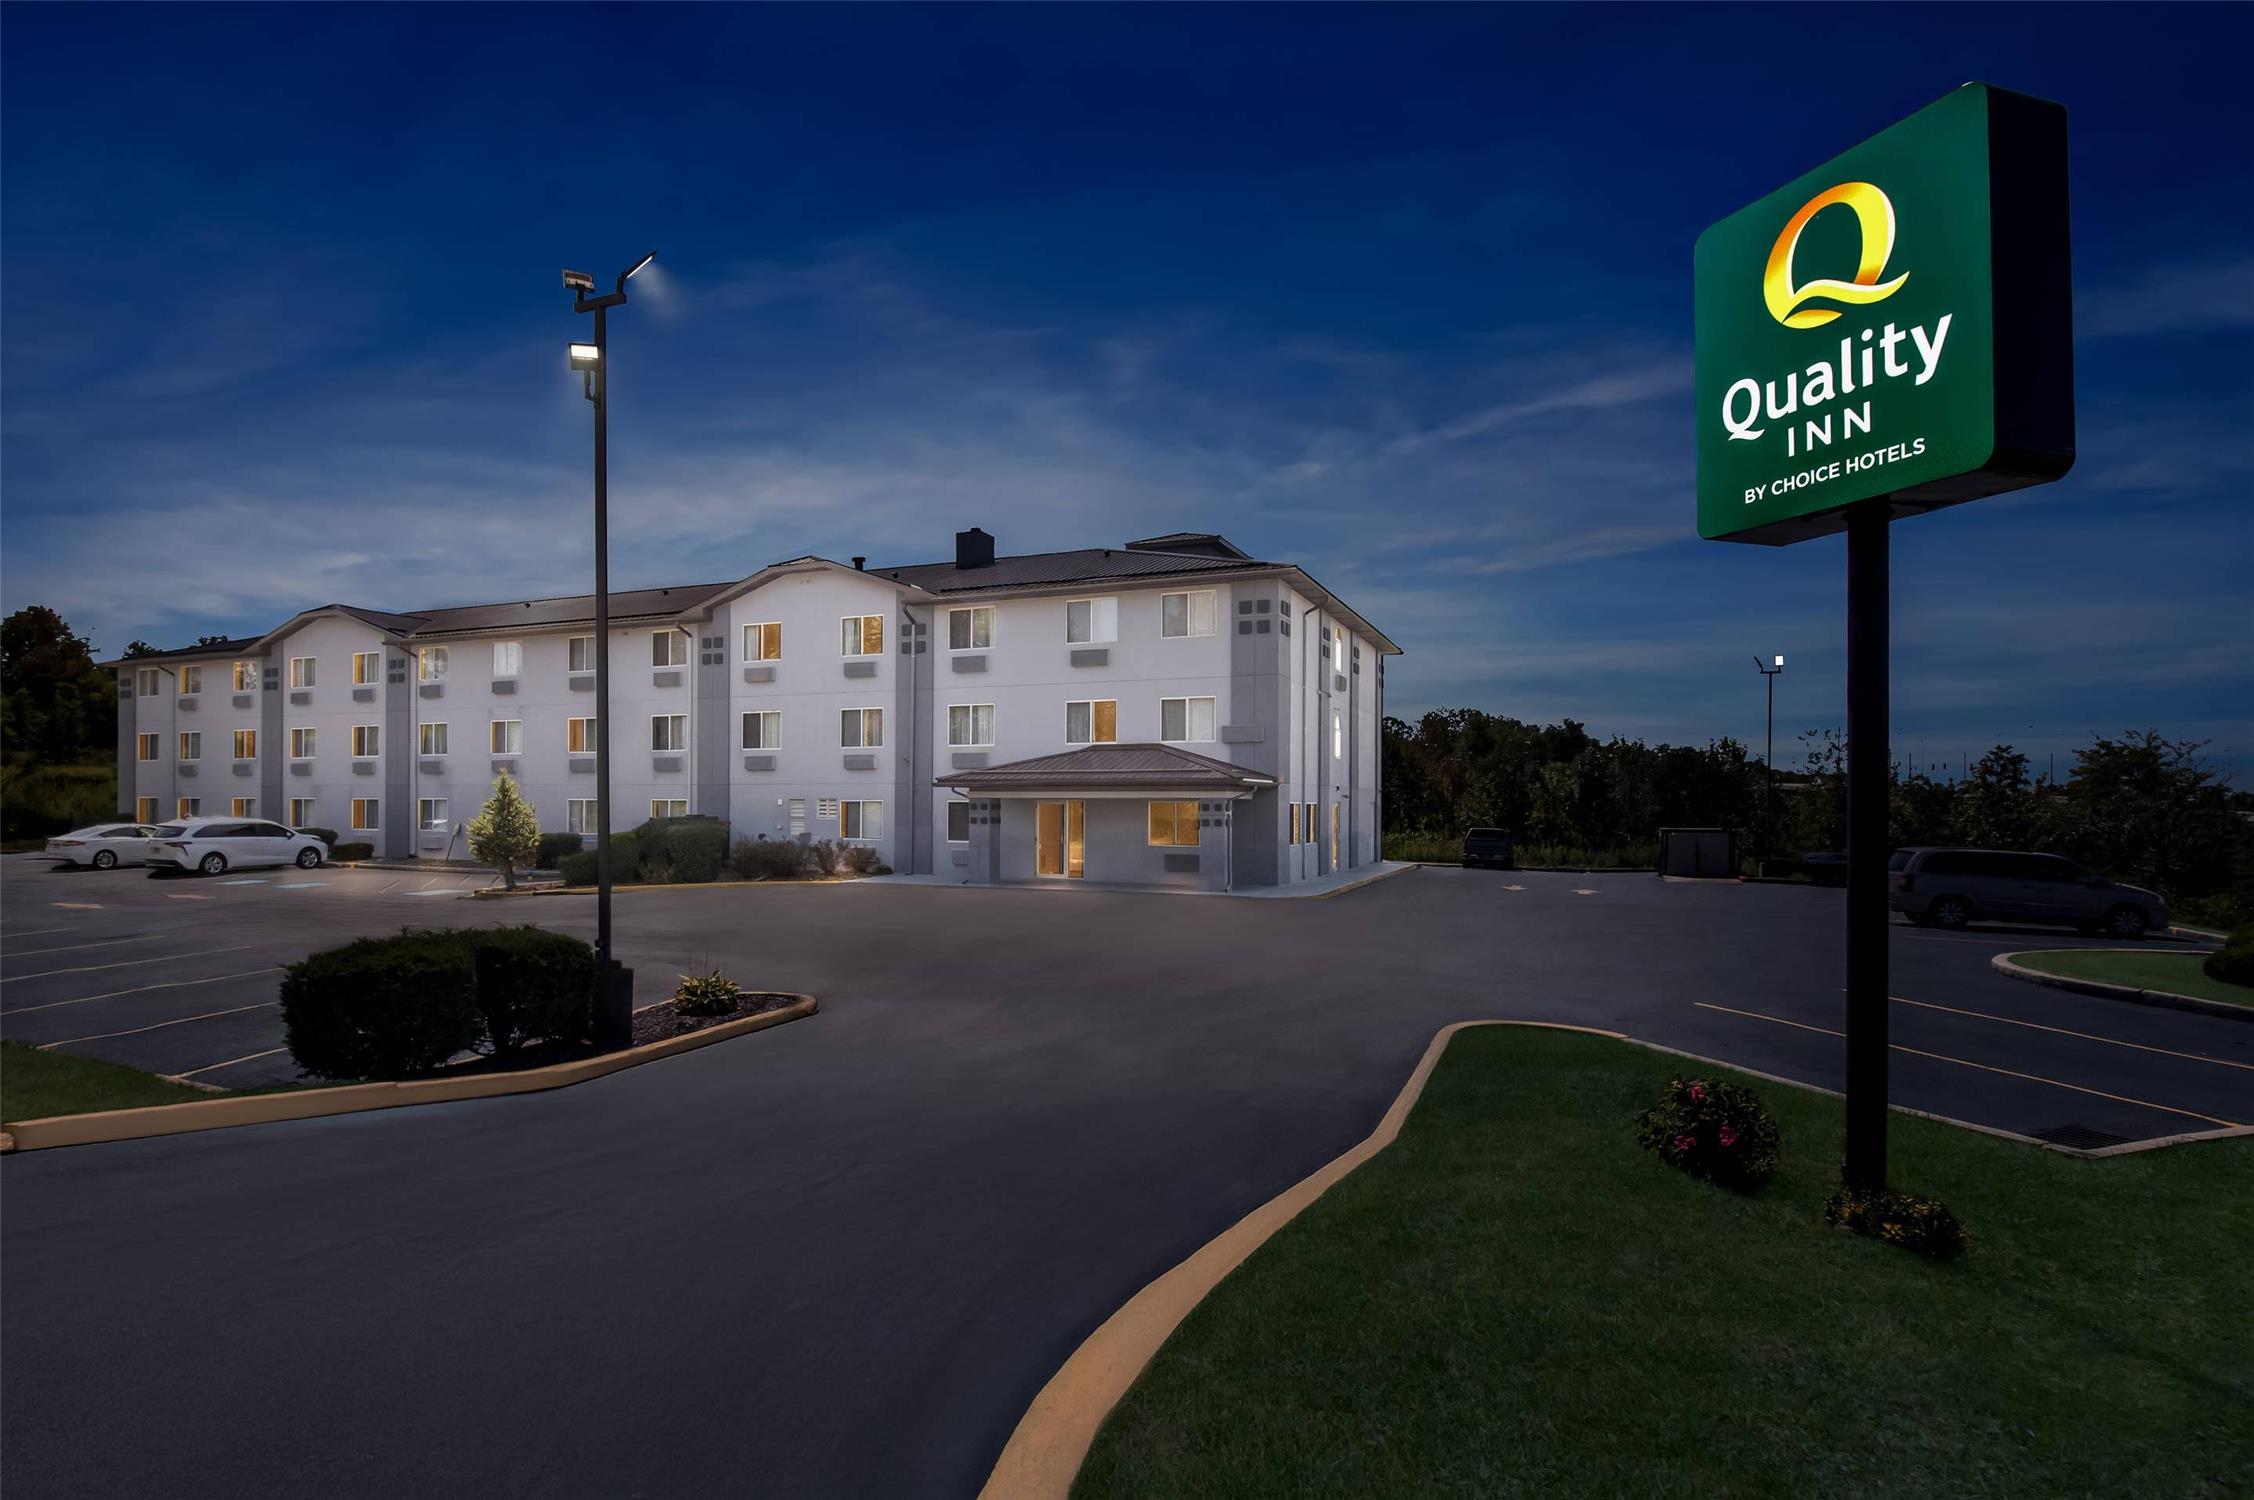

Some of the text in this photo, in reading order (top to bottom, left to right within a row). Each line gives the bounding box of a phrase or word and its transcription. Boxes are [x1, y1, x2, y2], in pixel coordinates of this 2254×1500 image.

[1722, 313, 1953, 441] Quality
[1786, 401, 1871, 458] INN
[1744, 437, 1926, 504] BY CHOICE HOTELS
